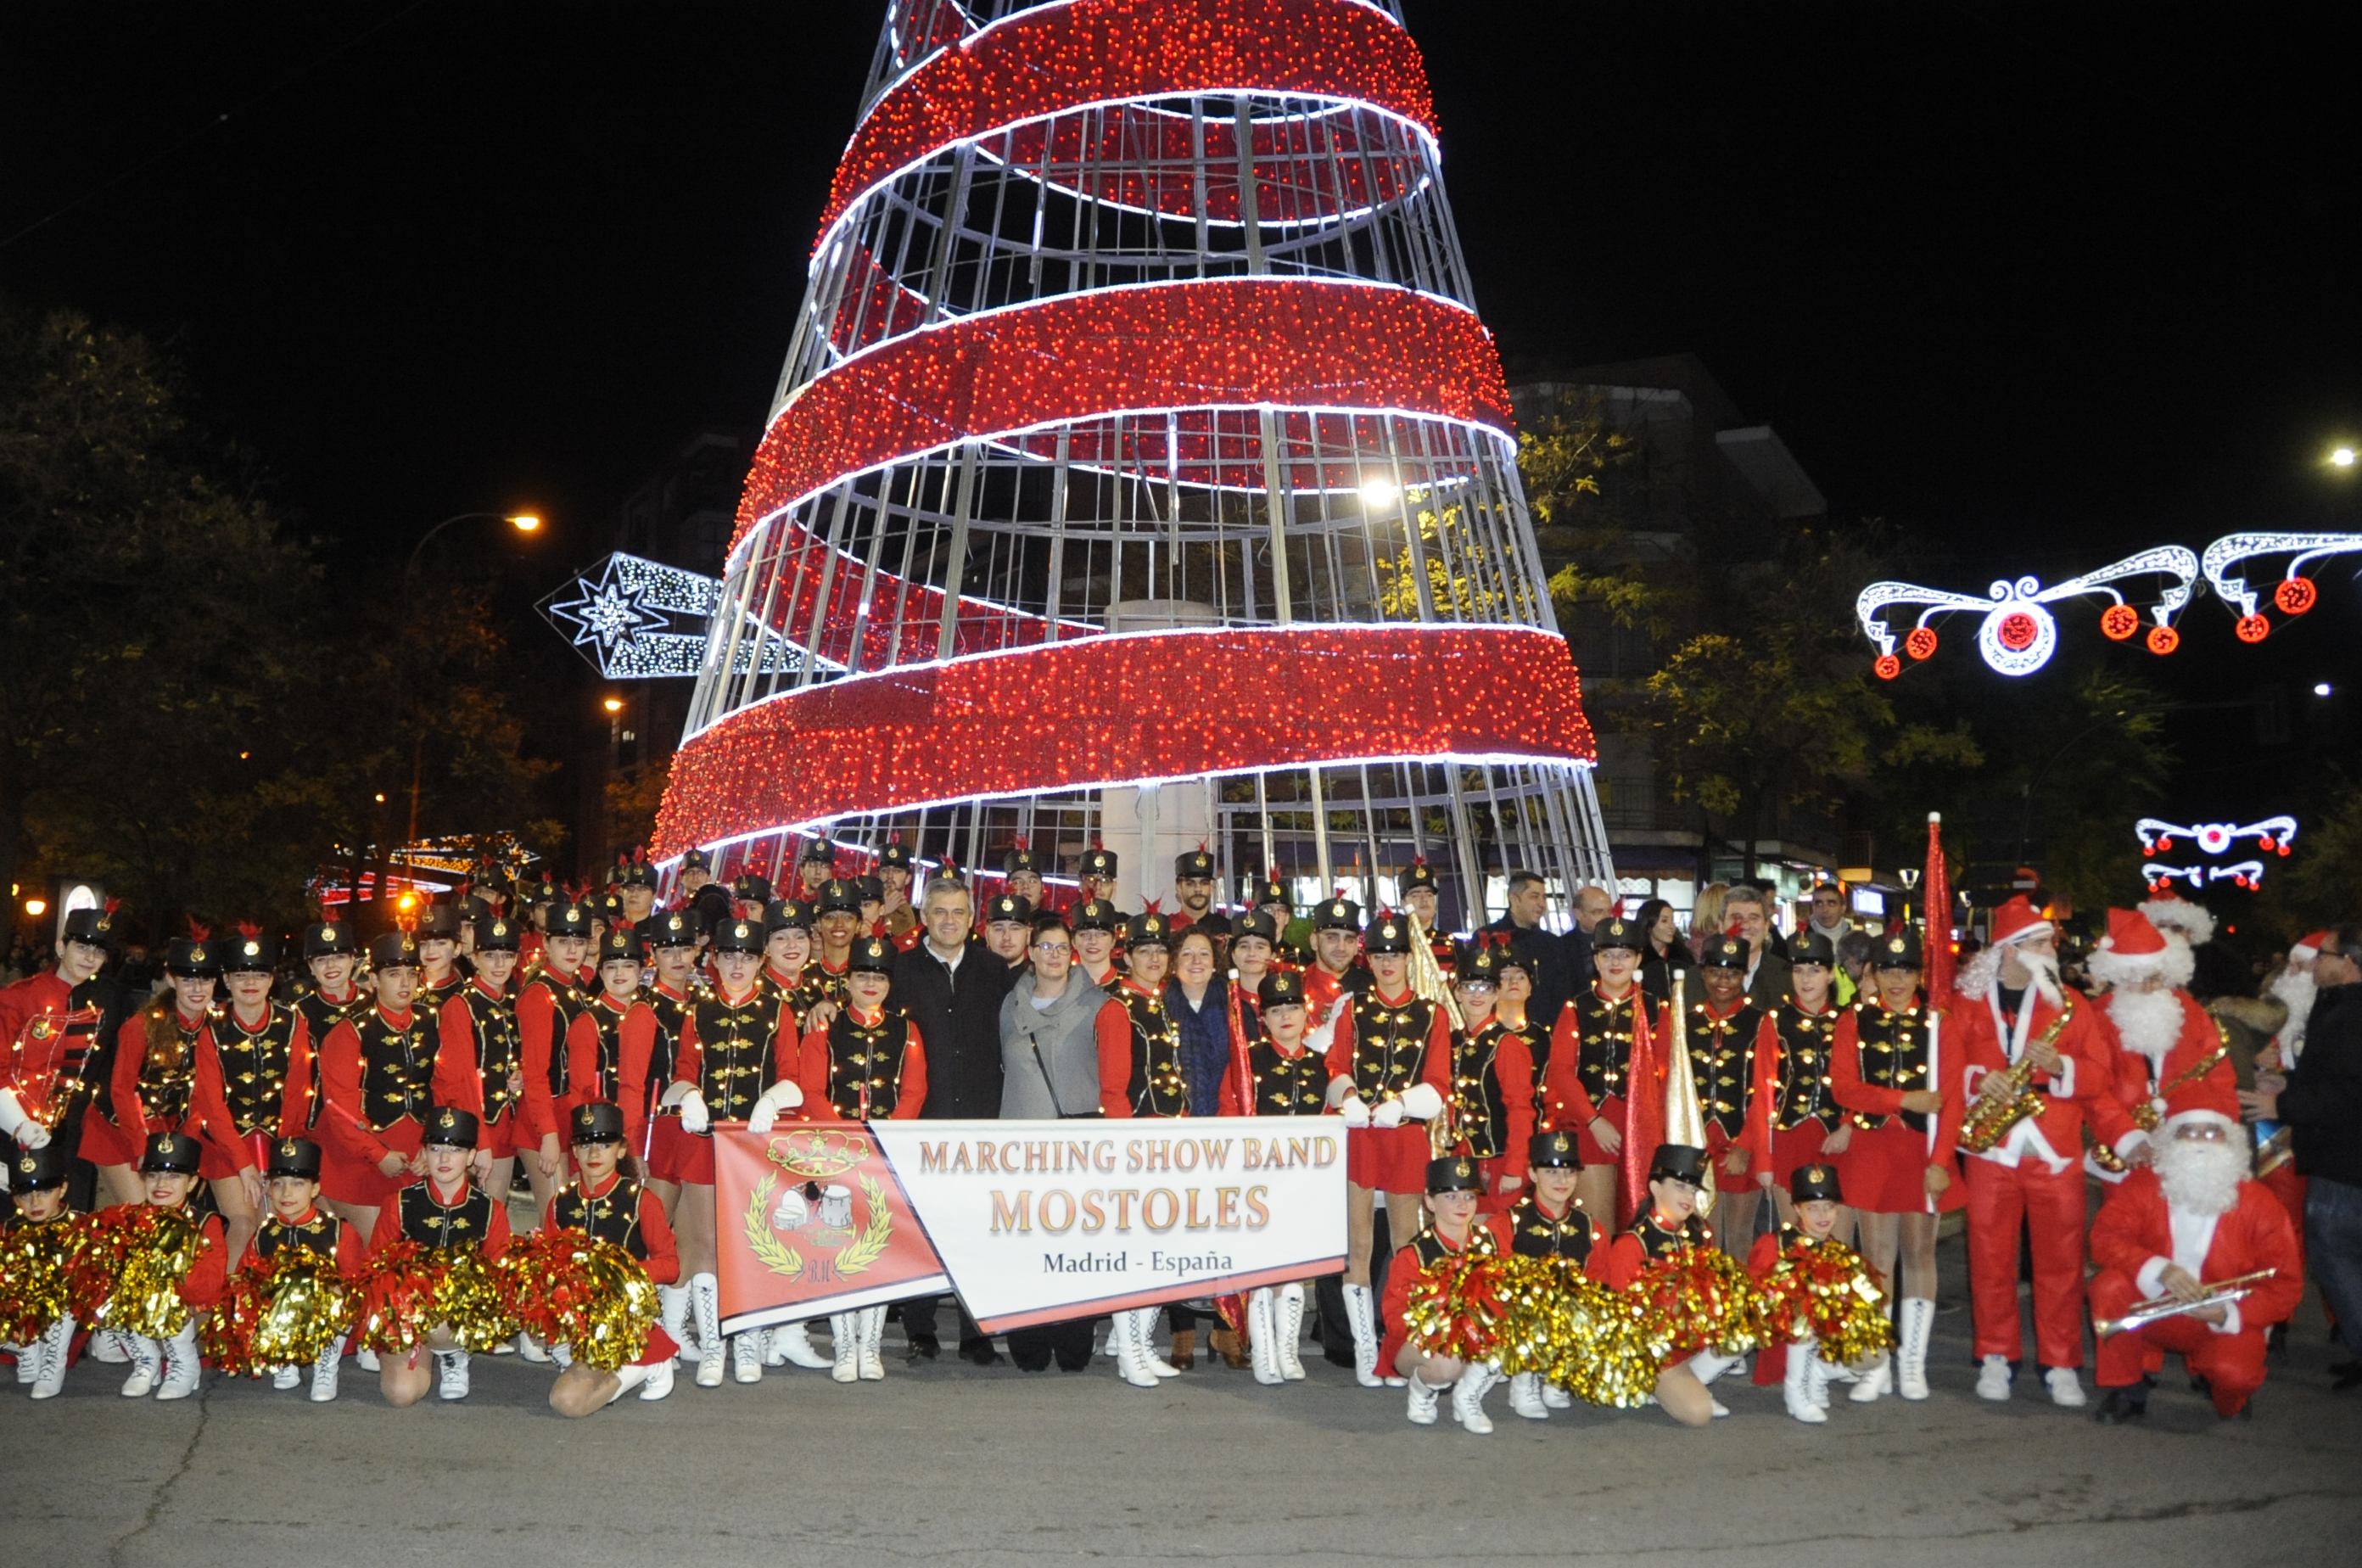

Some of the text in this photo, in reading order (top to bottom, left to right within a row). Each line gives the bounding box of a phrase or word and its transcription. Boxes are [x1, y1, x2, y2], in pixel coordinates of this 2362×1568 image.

[919, 1135, 1338, 1172] MARCHING SHOW BAND
[989, 1185, 1270, 1232] MOSTOLES
[1043, 1251, 1128, 1274] Madrid
[1150, 1251, 1234, 1277] España
